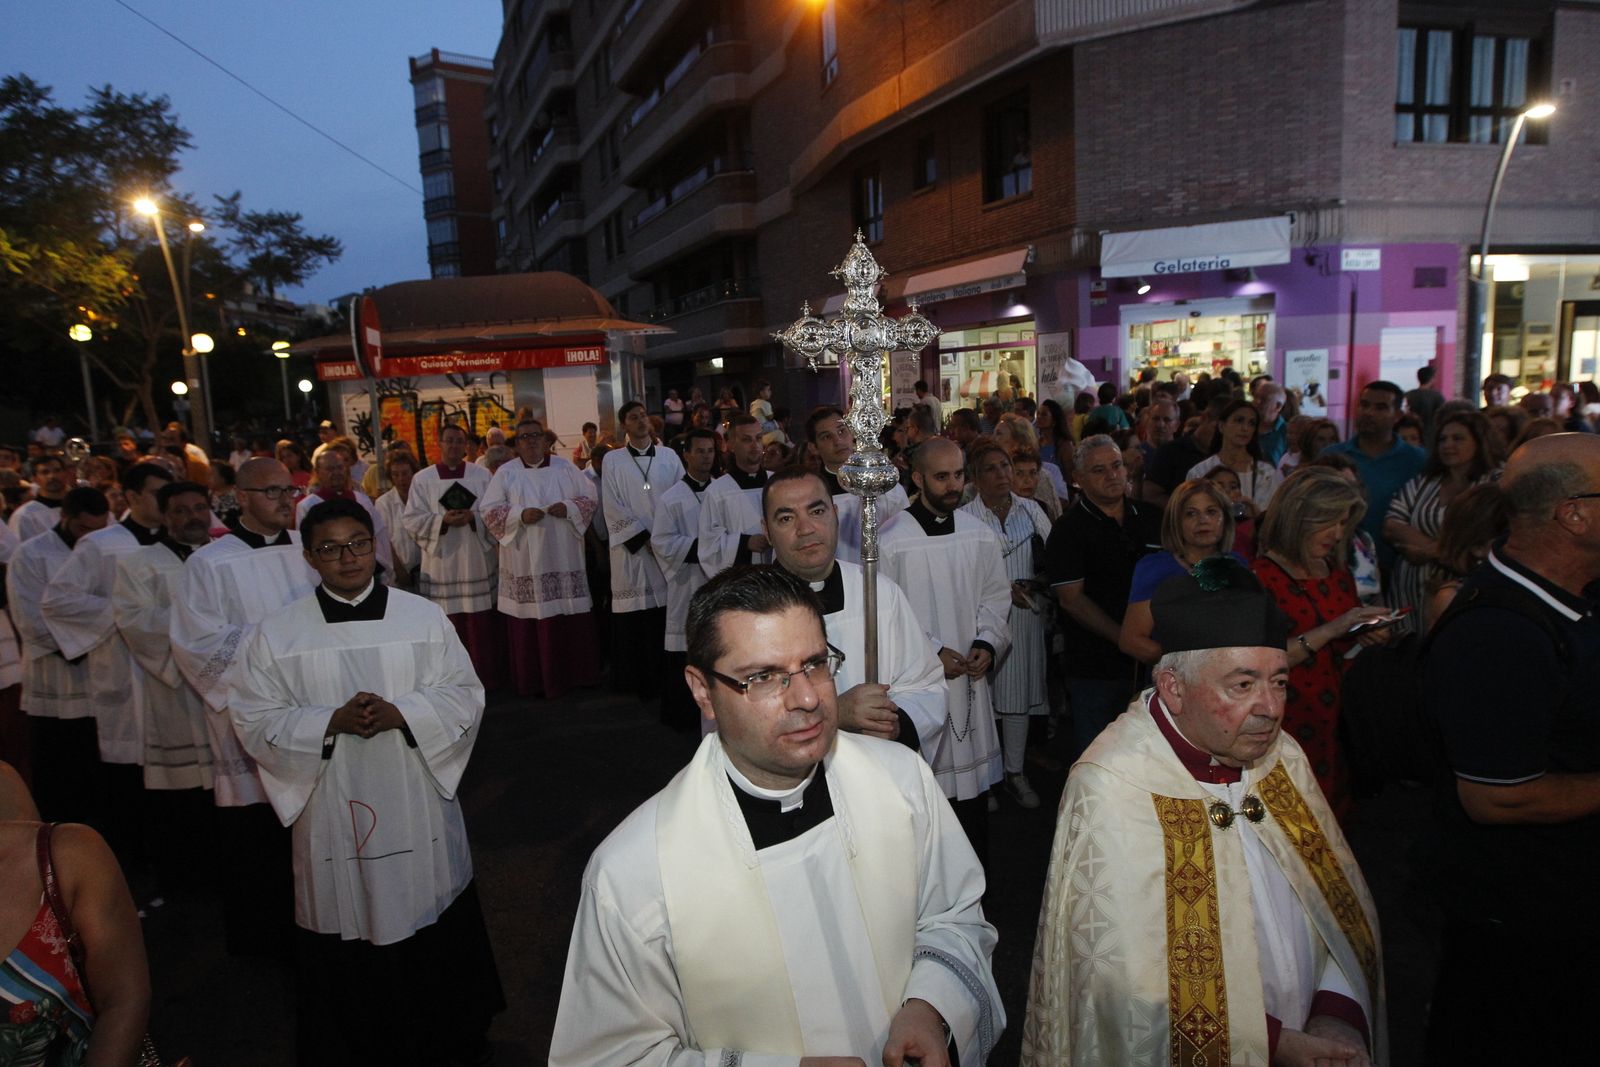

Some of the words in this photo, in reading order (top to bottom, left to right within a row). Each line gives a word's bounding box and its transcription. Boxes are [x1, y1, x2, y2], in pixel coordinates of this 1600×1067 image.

[1153, 256, 1230, 274] Gelateria
[566, 350, 599, 362] ¡HOLA!
[420, 360, 453, 369] Quiosco
